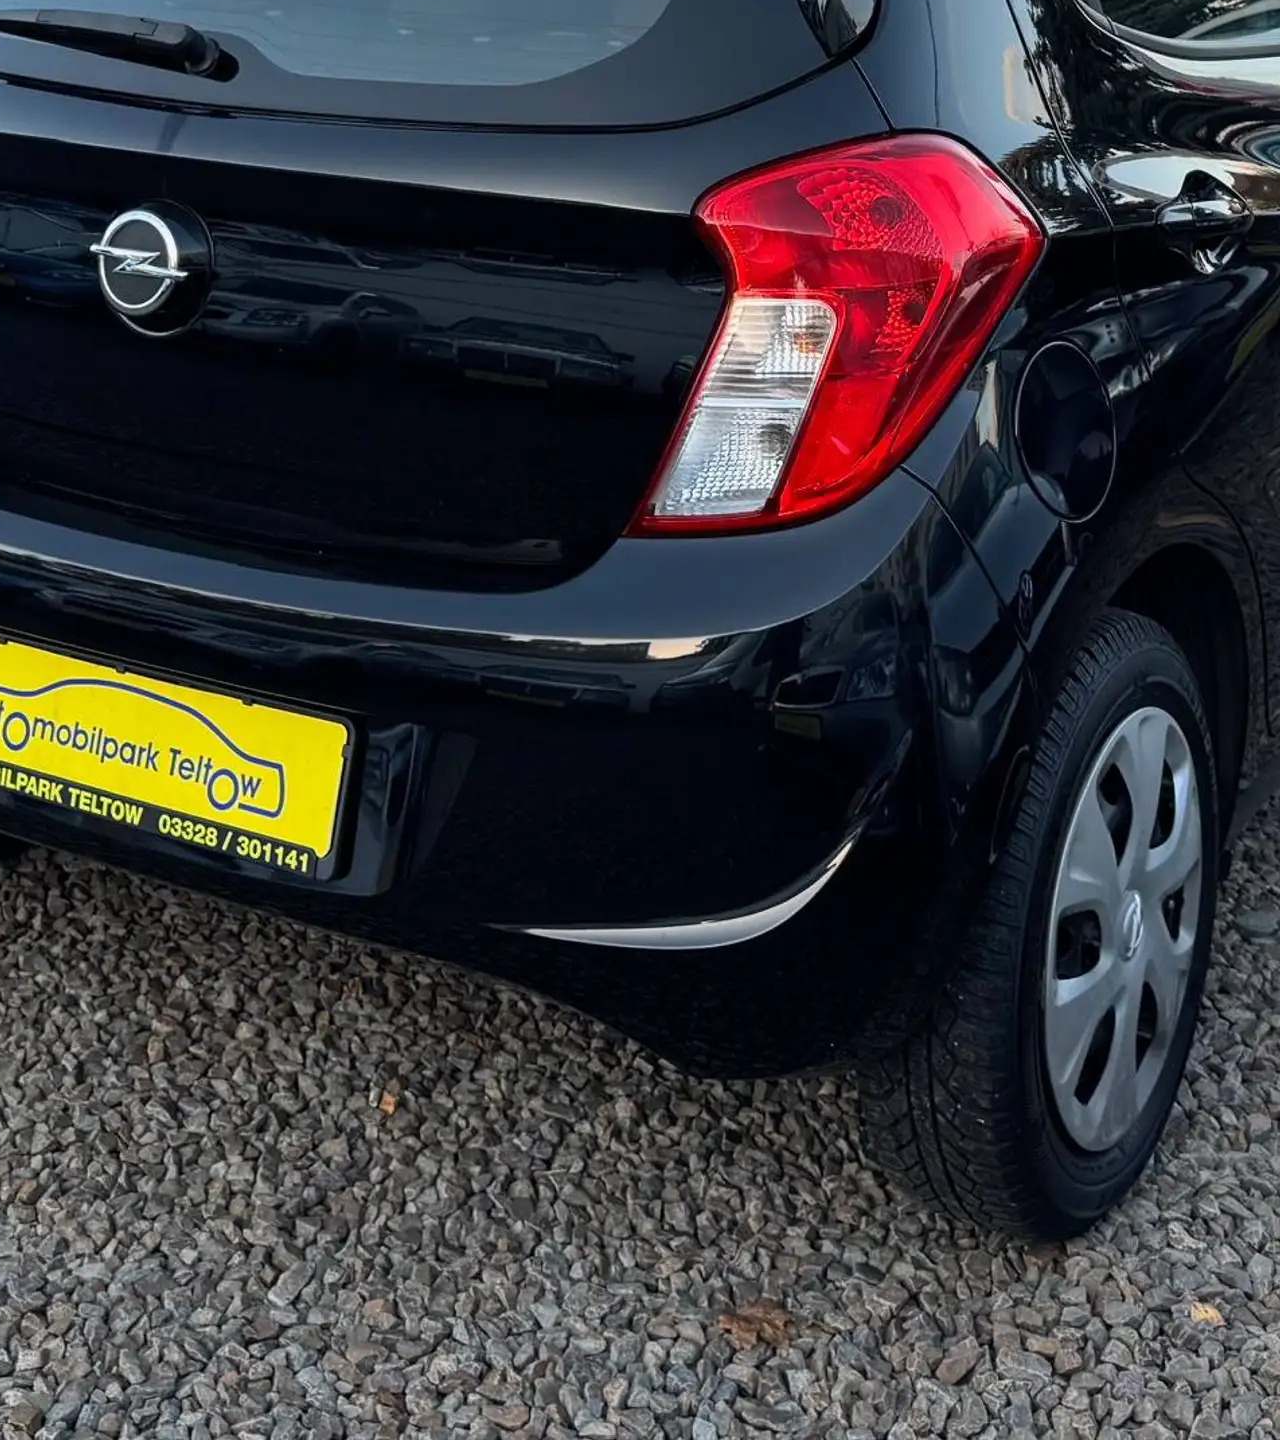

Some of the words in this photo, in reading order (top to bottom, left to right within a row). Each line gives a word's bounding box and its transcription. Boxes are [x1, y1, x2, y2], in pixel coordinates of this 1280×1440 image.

[67, 787, 143, 827] TELTOW
[158, 813, 218, 848] 03328
[222, 832, 232, 852] /
[236, 834, 309, 874] 301141
